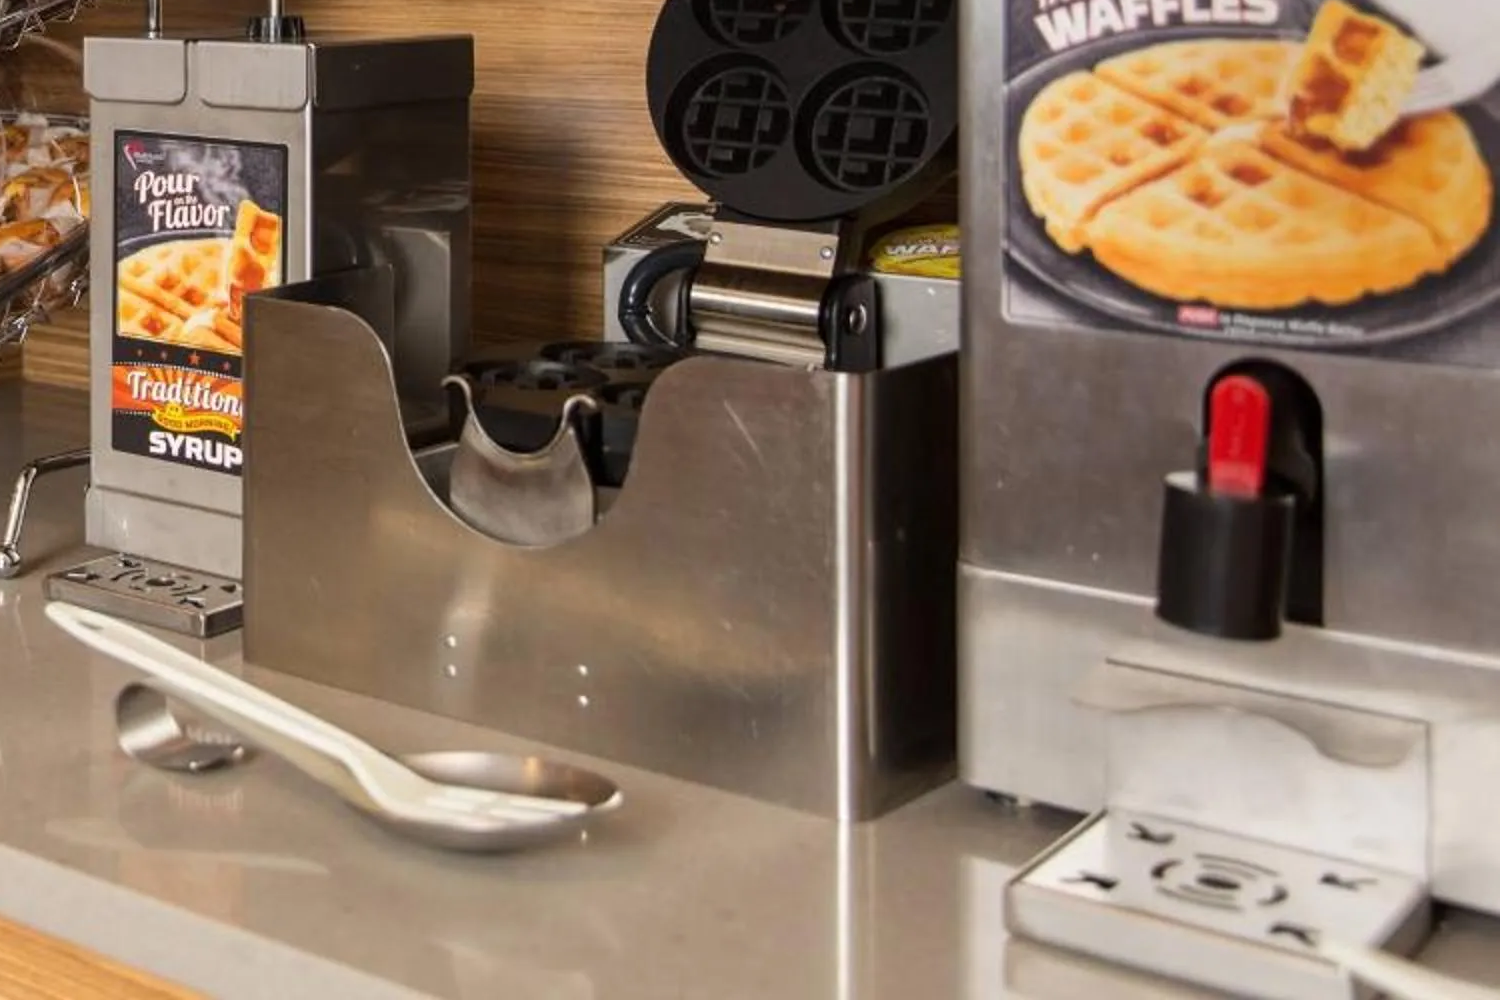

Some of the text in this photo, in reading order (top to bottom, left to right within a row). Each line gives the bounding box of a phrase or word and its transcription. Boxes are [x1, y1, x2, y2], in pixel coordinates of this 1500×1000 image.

[134, 170, 200, 204] Pour
[147, 199, 231, 232] Flavor
[127, 371, 242, 417] Tradition
[149, 431, 243, 469] SYRUP
